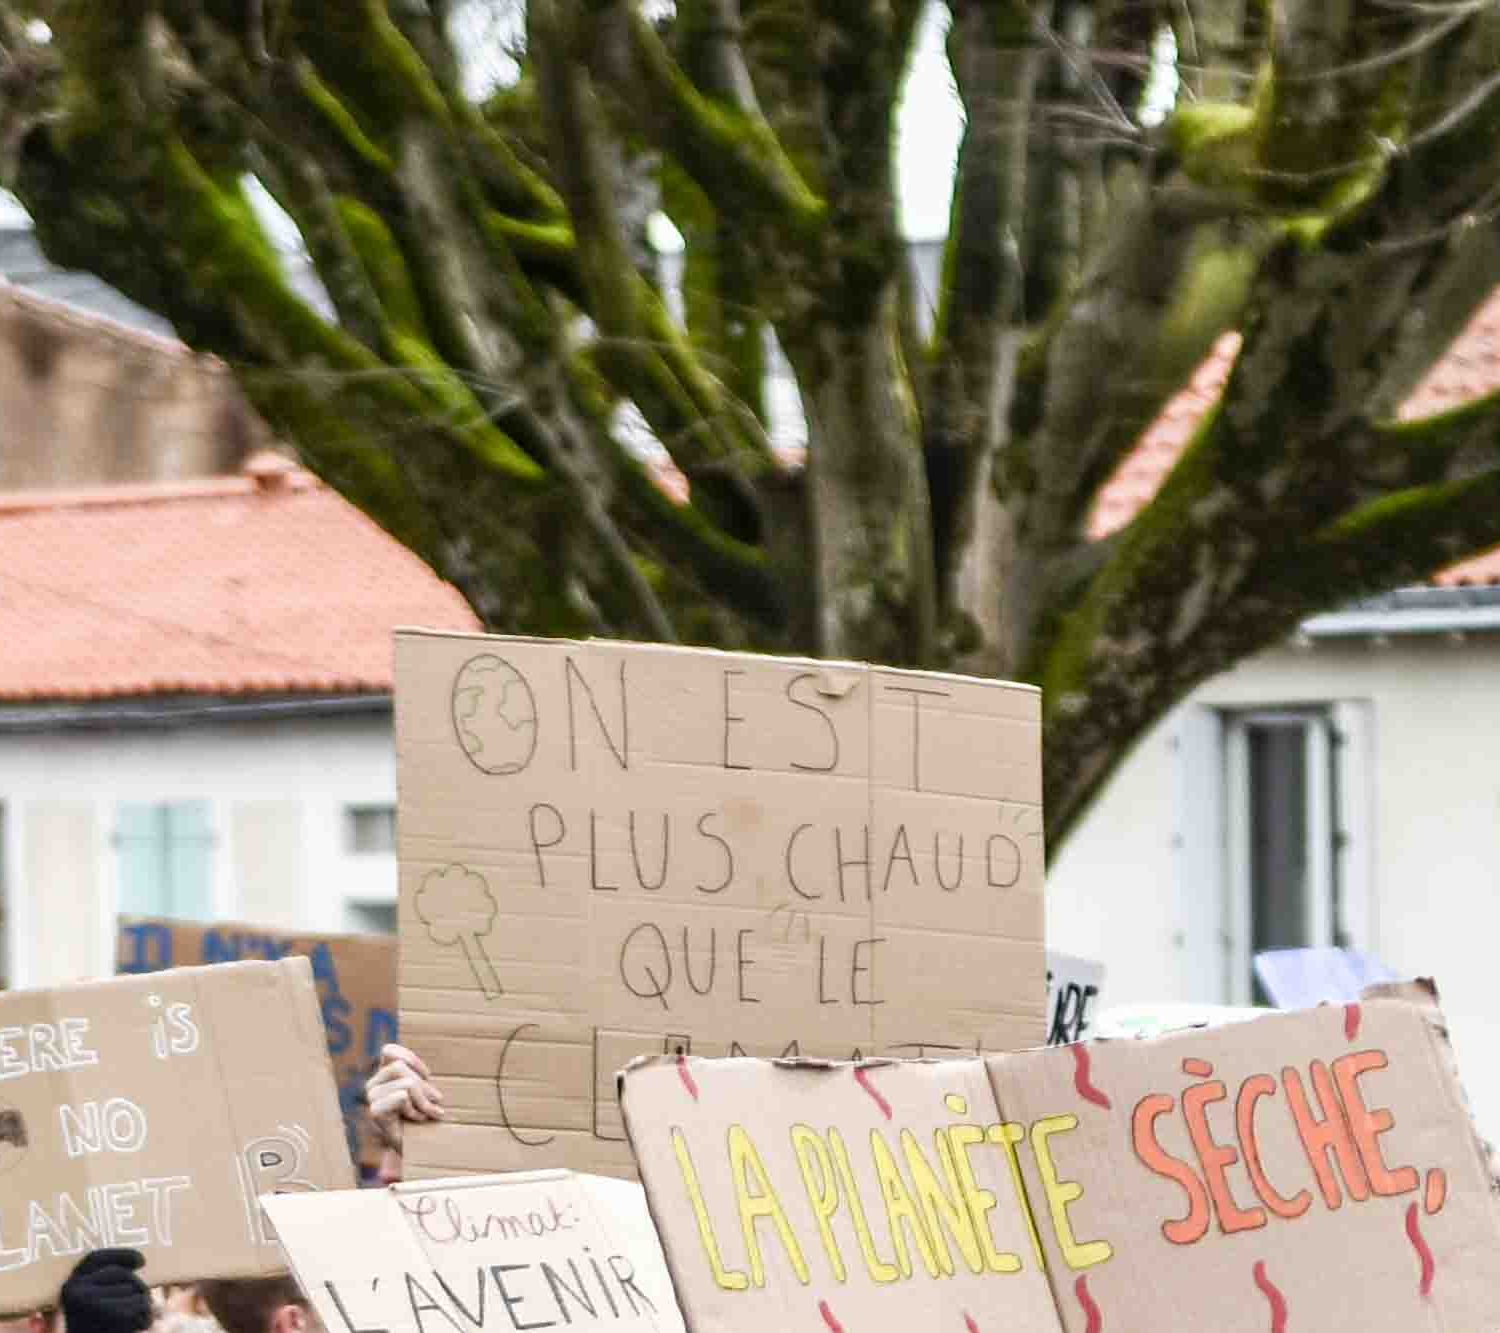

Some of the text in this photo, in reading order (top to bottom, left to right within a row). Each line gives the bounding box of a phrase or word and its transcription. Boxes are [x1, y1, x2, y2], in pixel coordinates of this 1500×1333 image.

[451, 653, 952, 792] ON EST
[527, 802, 1021, 902] PLUS CHAUD
[619, 922, 887, 1010] QUE LE
[59, 1098, 148, 1159] NO
[672, 1123, 809, 1291] LA
[789, 1094, 1114, 1285] PLANÈTE
[1130, 1048, 1449, 1245] SÈCHE,
